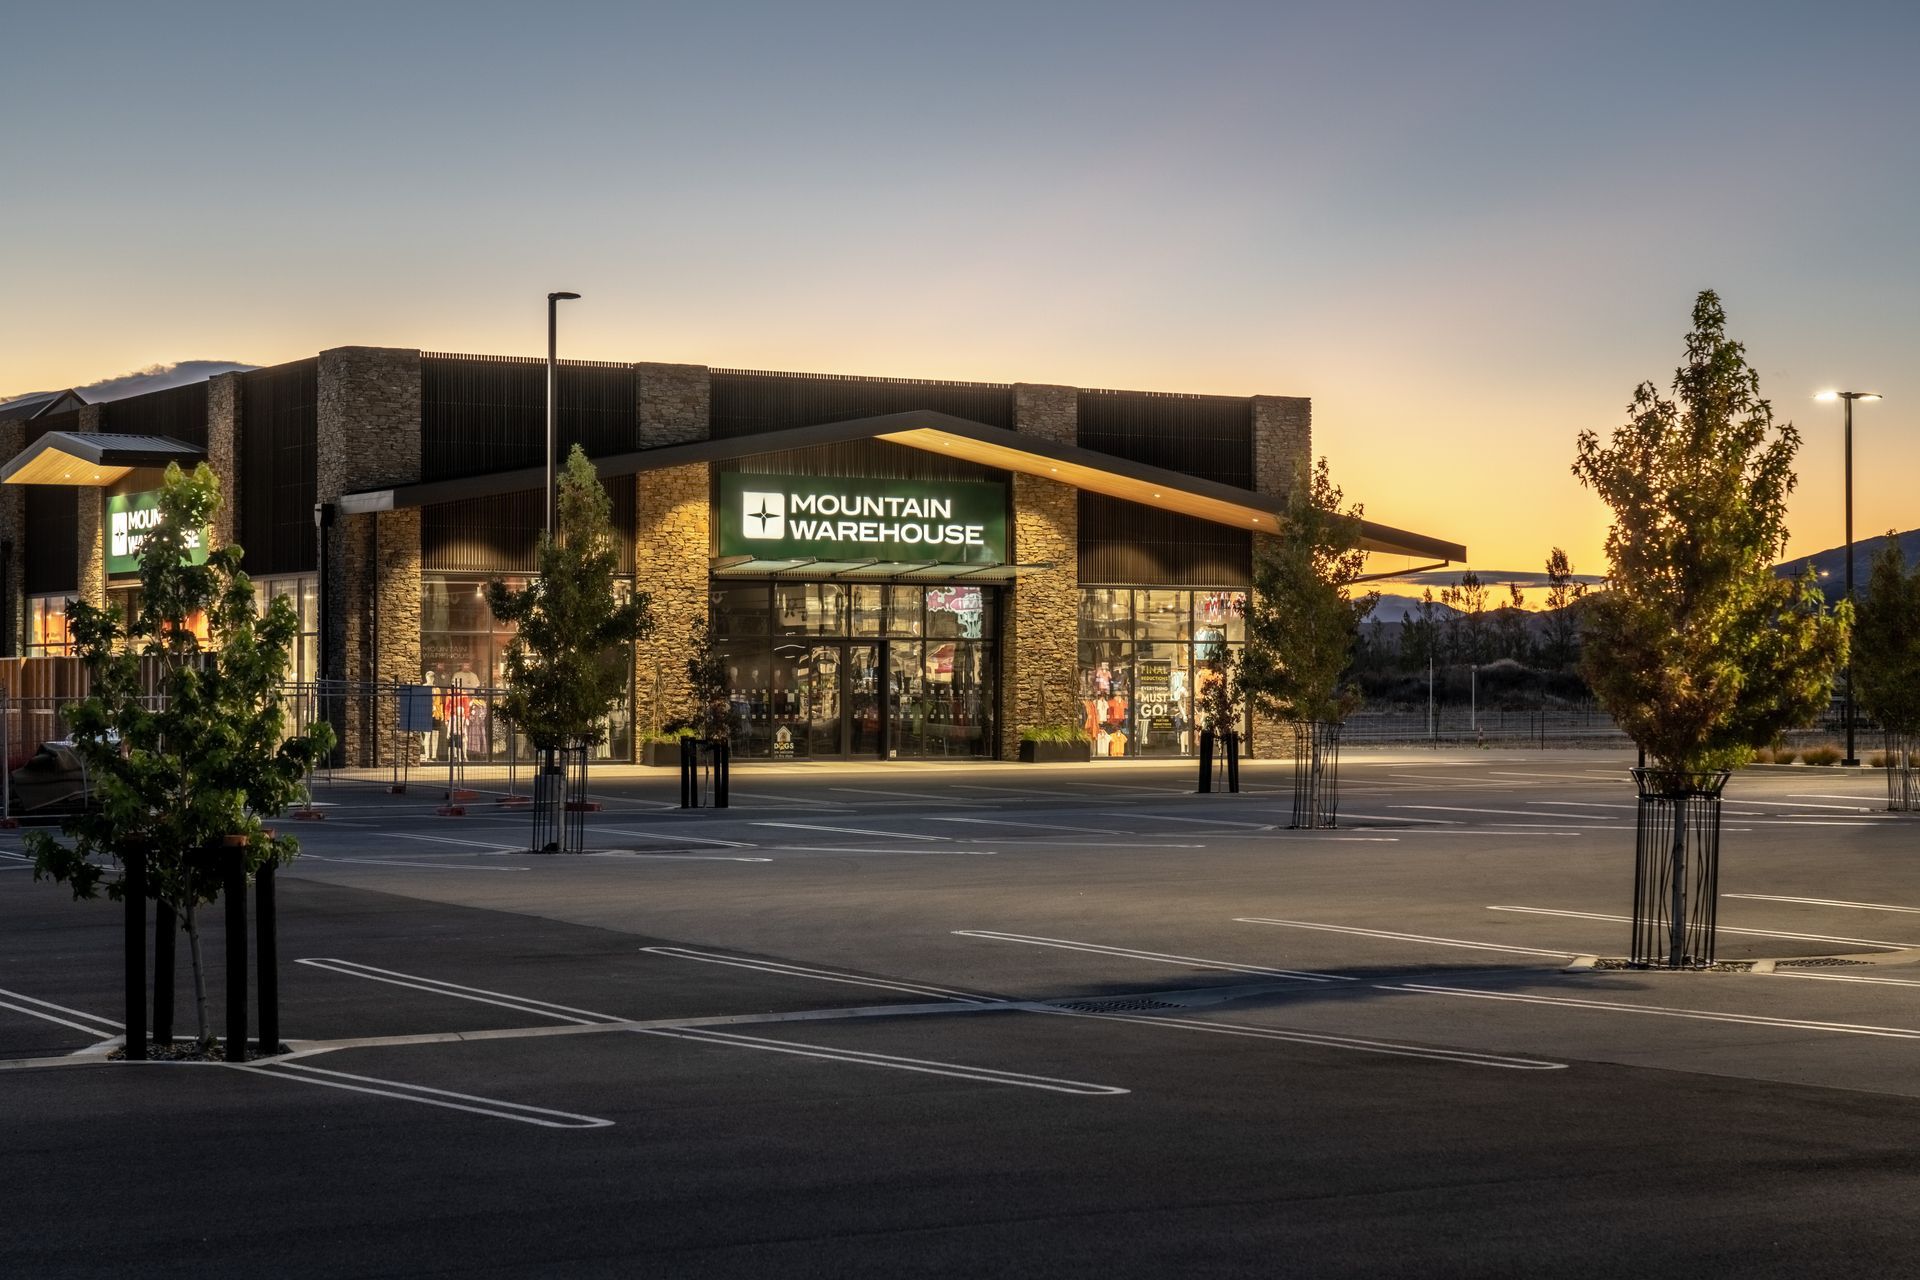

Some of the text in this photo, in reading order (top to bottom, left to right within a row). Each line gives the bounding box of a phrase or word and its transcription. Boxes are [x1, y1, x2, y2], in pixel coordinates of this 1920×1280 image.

[790, 494, 951, 519] MOUNTAIN
[128, 508, 162, 530] MOUN
[789, 520, 984, 545] WAREHOUSE
[1141, 666, 1168, 674] FINAL
[1141, 693, 1168, 703] MUST
[1141, 703, 1168, 717] GO!
